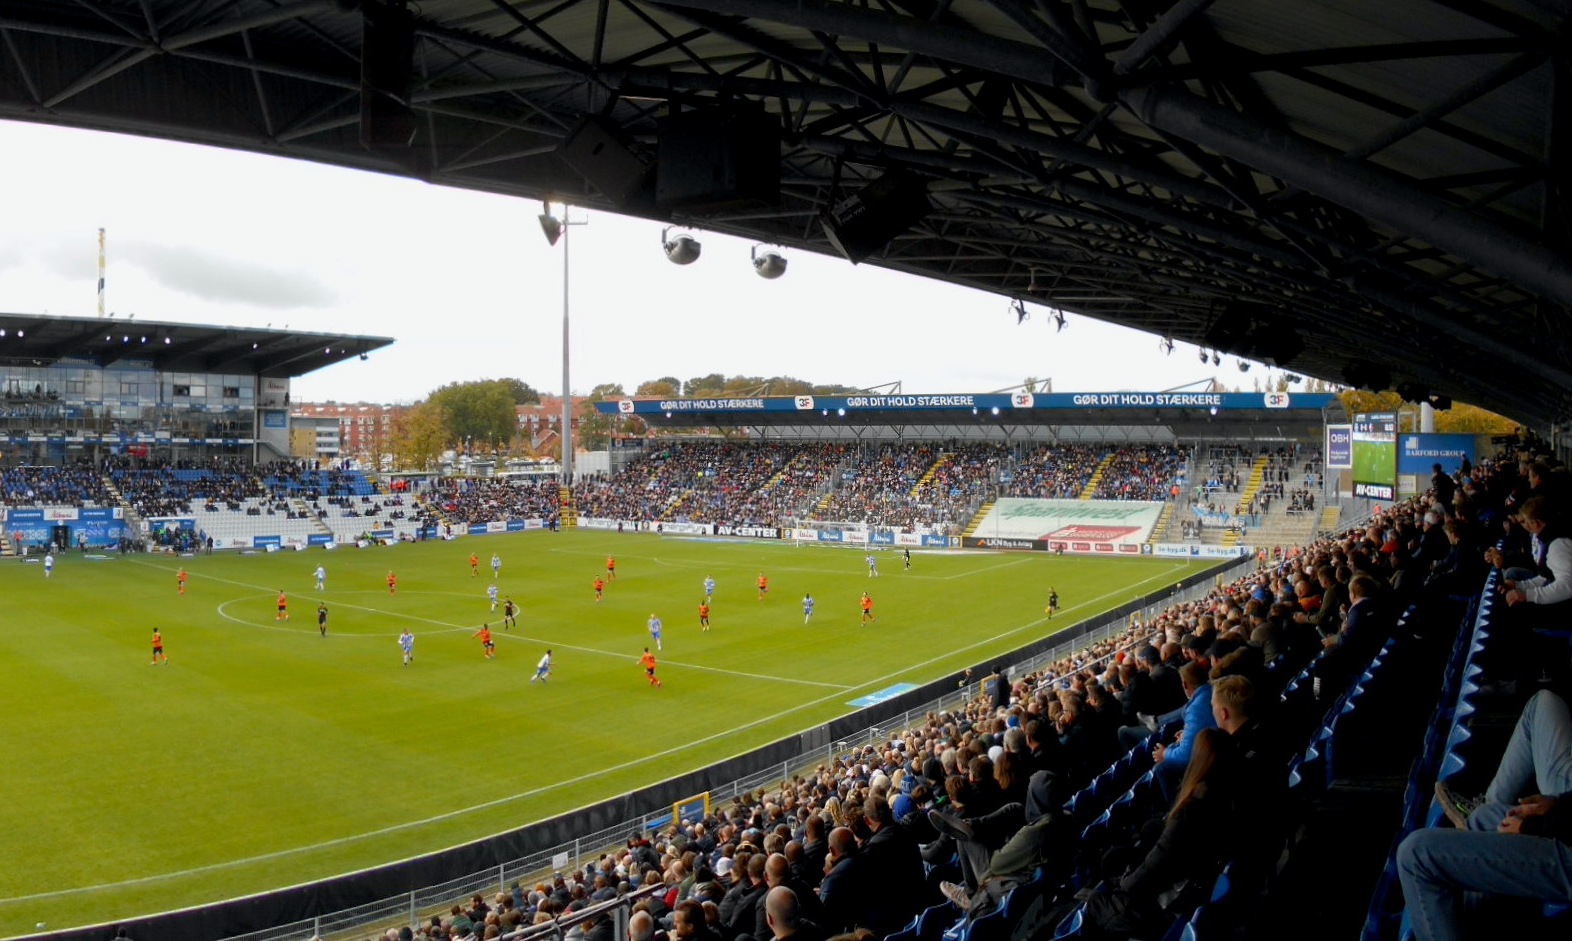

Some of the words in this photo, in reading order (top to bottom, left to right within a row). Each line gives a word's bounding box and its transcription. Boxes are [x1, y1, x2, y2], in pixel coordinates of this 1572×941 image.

[660, 400, 678, 410] GØR
[679, 400, 692, 409] DIT
[693, 399, 716, 409] HOLD
[718, 399, 764, 409] STÆRKERE
[799, 398, 810, 408] 3F
[847, 396, 870, 407] GØR
[871, 396, 888, 406] DIT
[889, 396, 915, 406] HOLD
[918, 395, 974, 406] STÆRKERE
[1016, 395, 1029, 405] 3F
[1073, 395, 1098, 405] GØR
[1100, 395, 1120, 405] DIT
[1121, 395, 1154, 405] HOLD
[1156, 394, 1221, 405] STÆRKERE
[1269, 394, 1285, 405] 3F
[1330, 433, 1349, 443] OBH
[1356, 484, 1392, 498] AV-CENTER
[718, 526, 777, 537] AV-CENTER
[821, 531, 839, 540] Albani
[872, 532, 890, 542] Albani
[927, 536, 945, 545] Albani
[986, 538, 1003, 547] LKN
